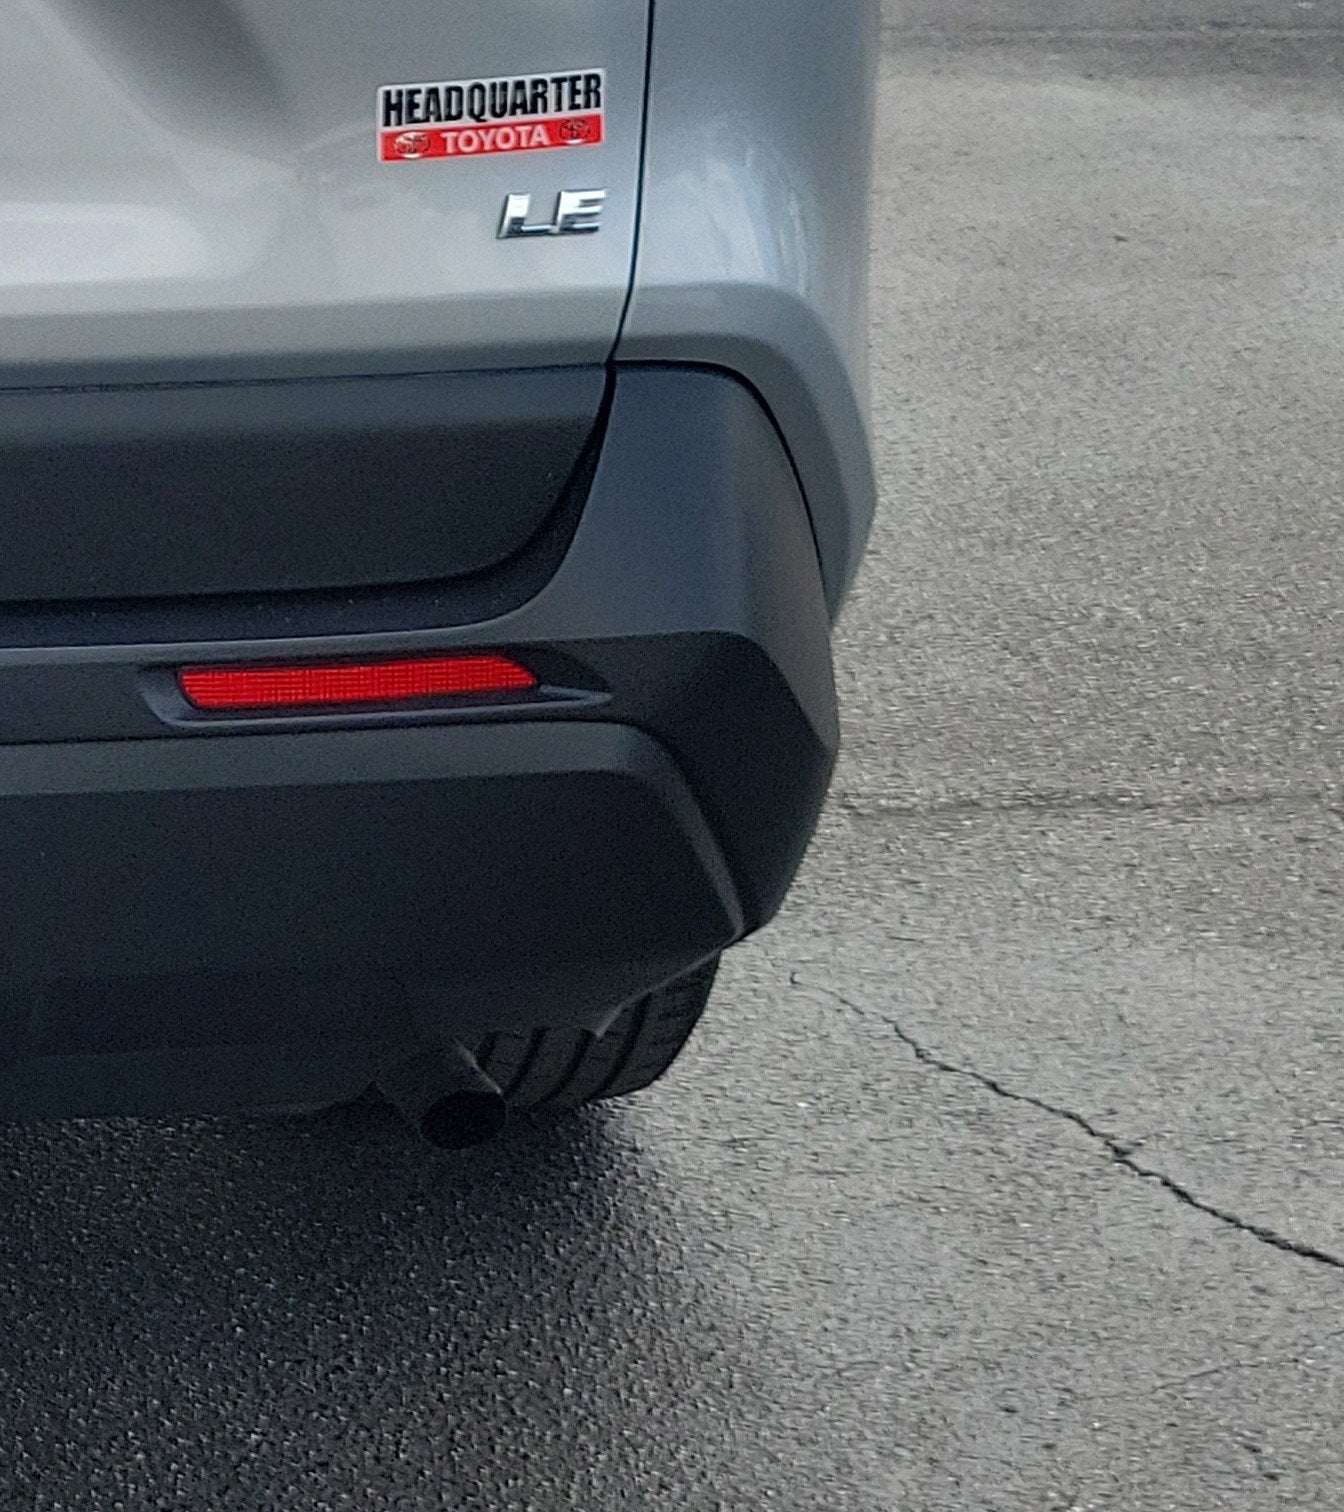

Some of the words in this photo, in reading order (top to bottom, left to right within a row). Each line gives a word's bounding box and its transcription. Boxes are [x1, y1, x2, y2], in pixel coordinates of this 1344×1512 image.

[382, 73, 602, 126] HEADQUARTER
[440, 124, 550, 154] TOYOTA
[496, 189, 607, 239] LE
